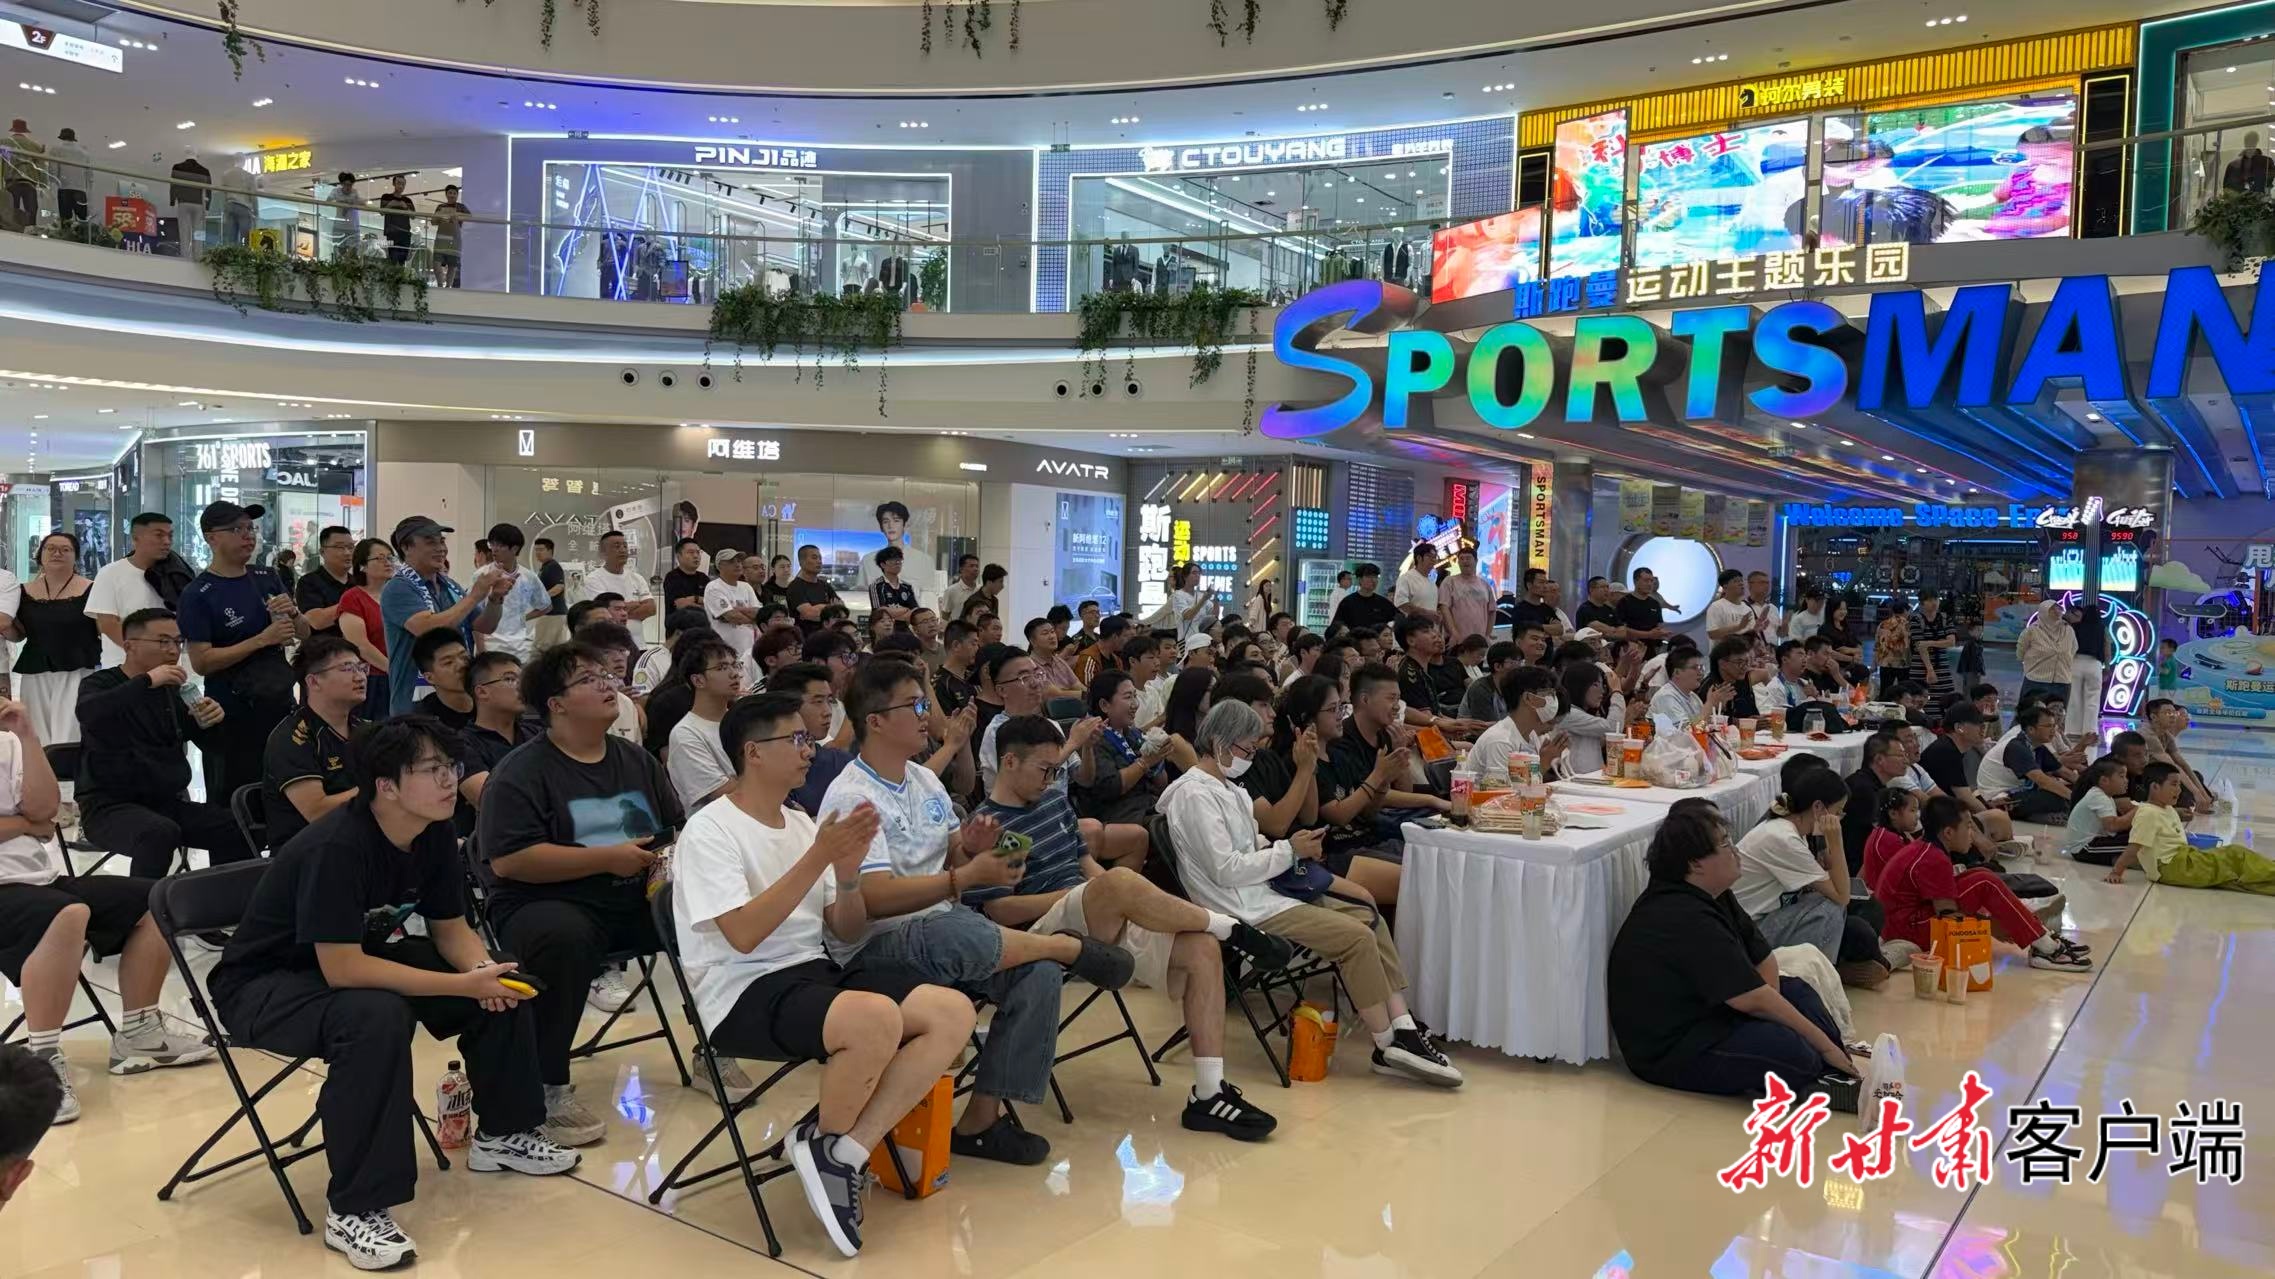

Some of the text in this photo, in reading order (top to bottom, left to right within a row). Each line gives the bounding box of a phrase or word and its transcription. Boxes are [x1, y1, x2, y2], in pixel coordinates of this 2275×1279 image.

[694, 146, 778, 166] PINJI
[1182, 138, 1345, 168] CTOUYANG
[1259, 265, 2275, 438] SPORTSMAN
[707, 438, 780, 460] 阿维塔
[1036, 459, 1109, 480] AVATR
[1534, 476, 1547, 558] SPORTSMAN
[1192, 545, 1237, 562] SPORTS
